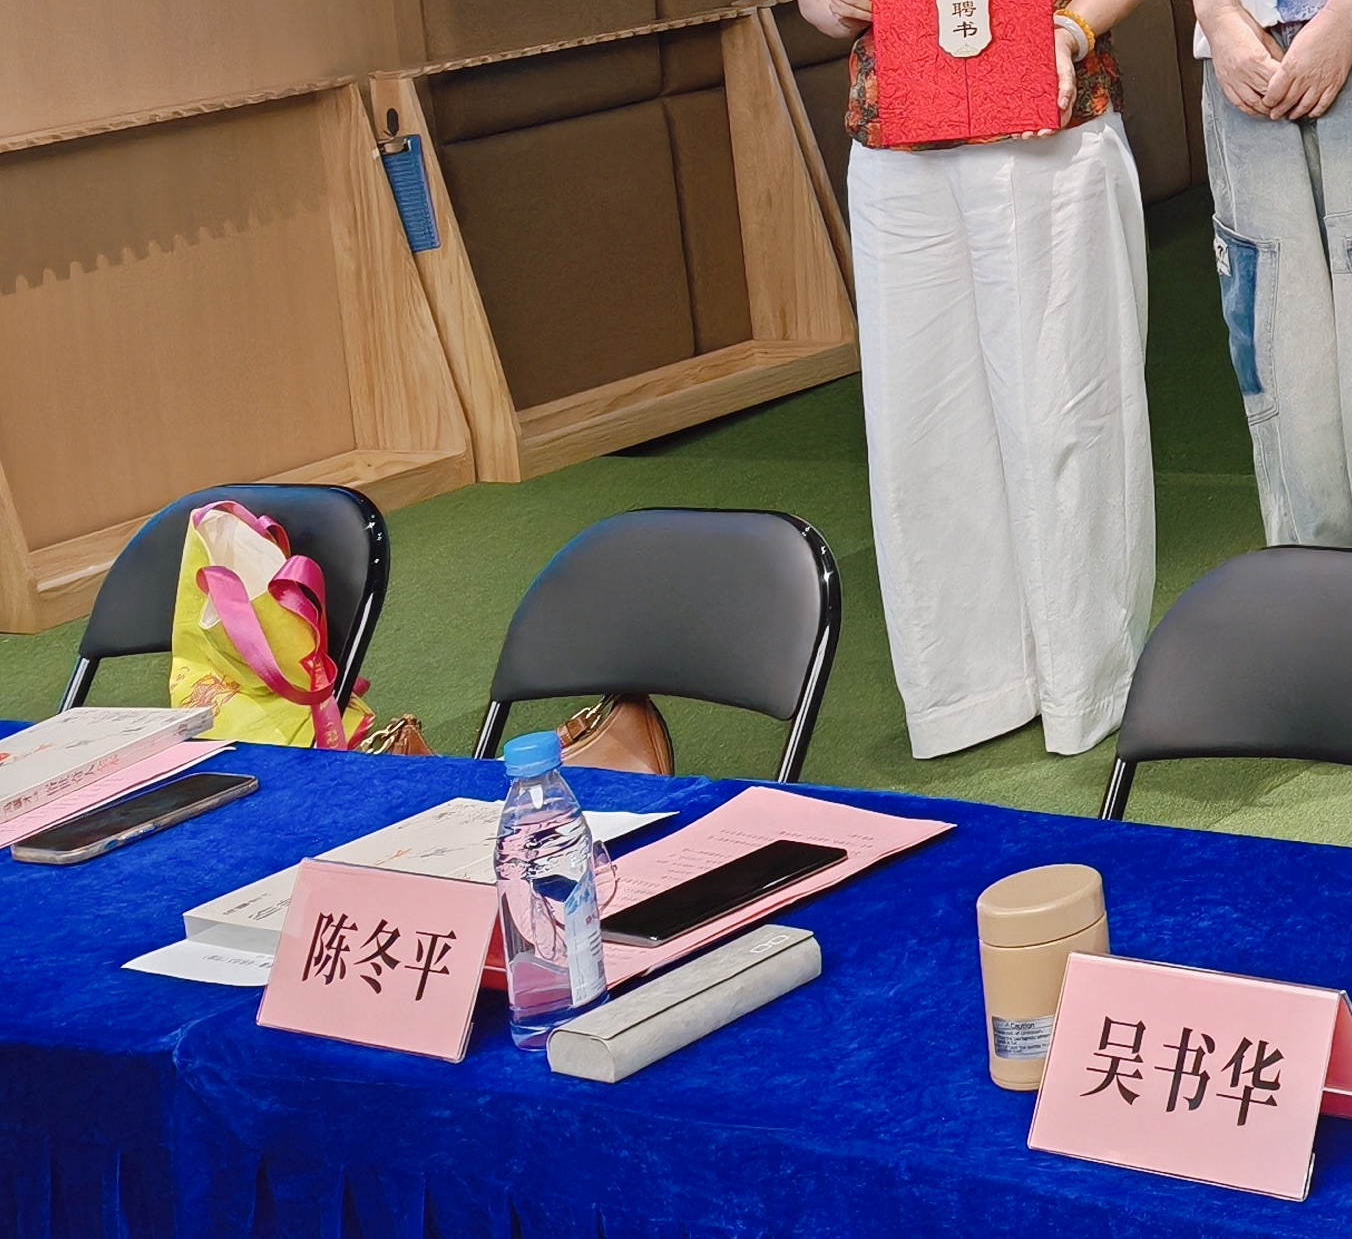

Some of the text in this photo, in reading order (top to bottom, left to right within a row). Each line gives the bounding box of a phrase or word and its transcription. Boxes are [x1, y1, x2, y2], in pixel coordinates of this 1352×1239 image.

[951, 0, 978, 39] 聘书
[301, 912, 457, 1001] 陈冬平
[1079, 1015, 1285, 1126] 吴书华
